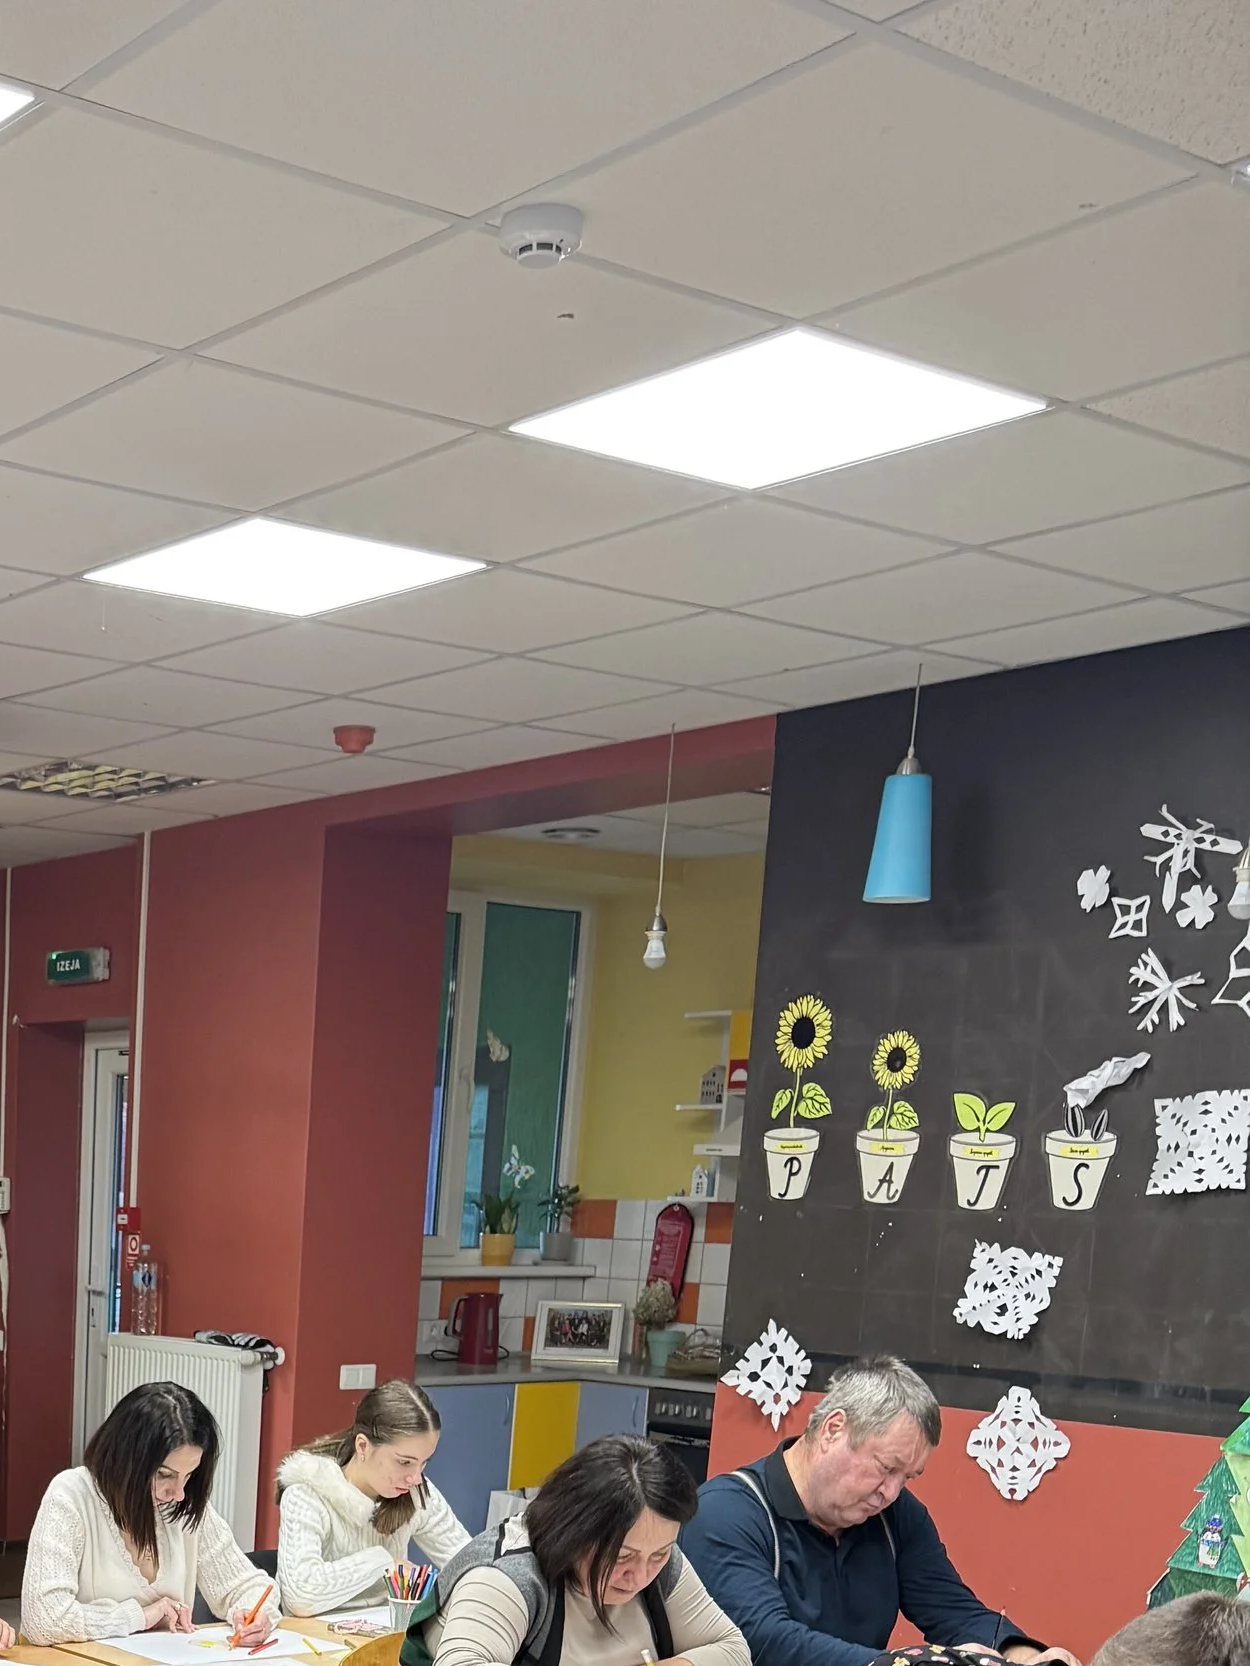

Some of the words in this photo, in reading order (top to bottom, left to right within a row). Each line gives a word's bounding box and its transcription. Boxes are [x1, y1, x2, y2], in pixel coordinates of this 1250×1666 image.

[56, 959, 80, 972] IZEJA
[778, 1156, 802, 1198] P
[867, 1161, 899, 1201] A
[1062, 1162, 1090, 1207] S
